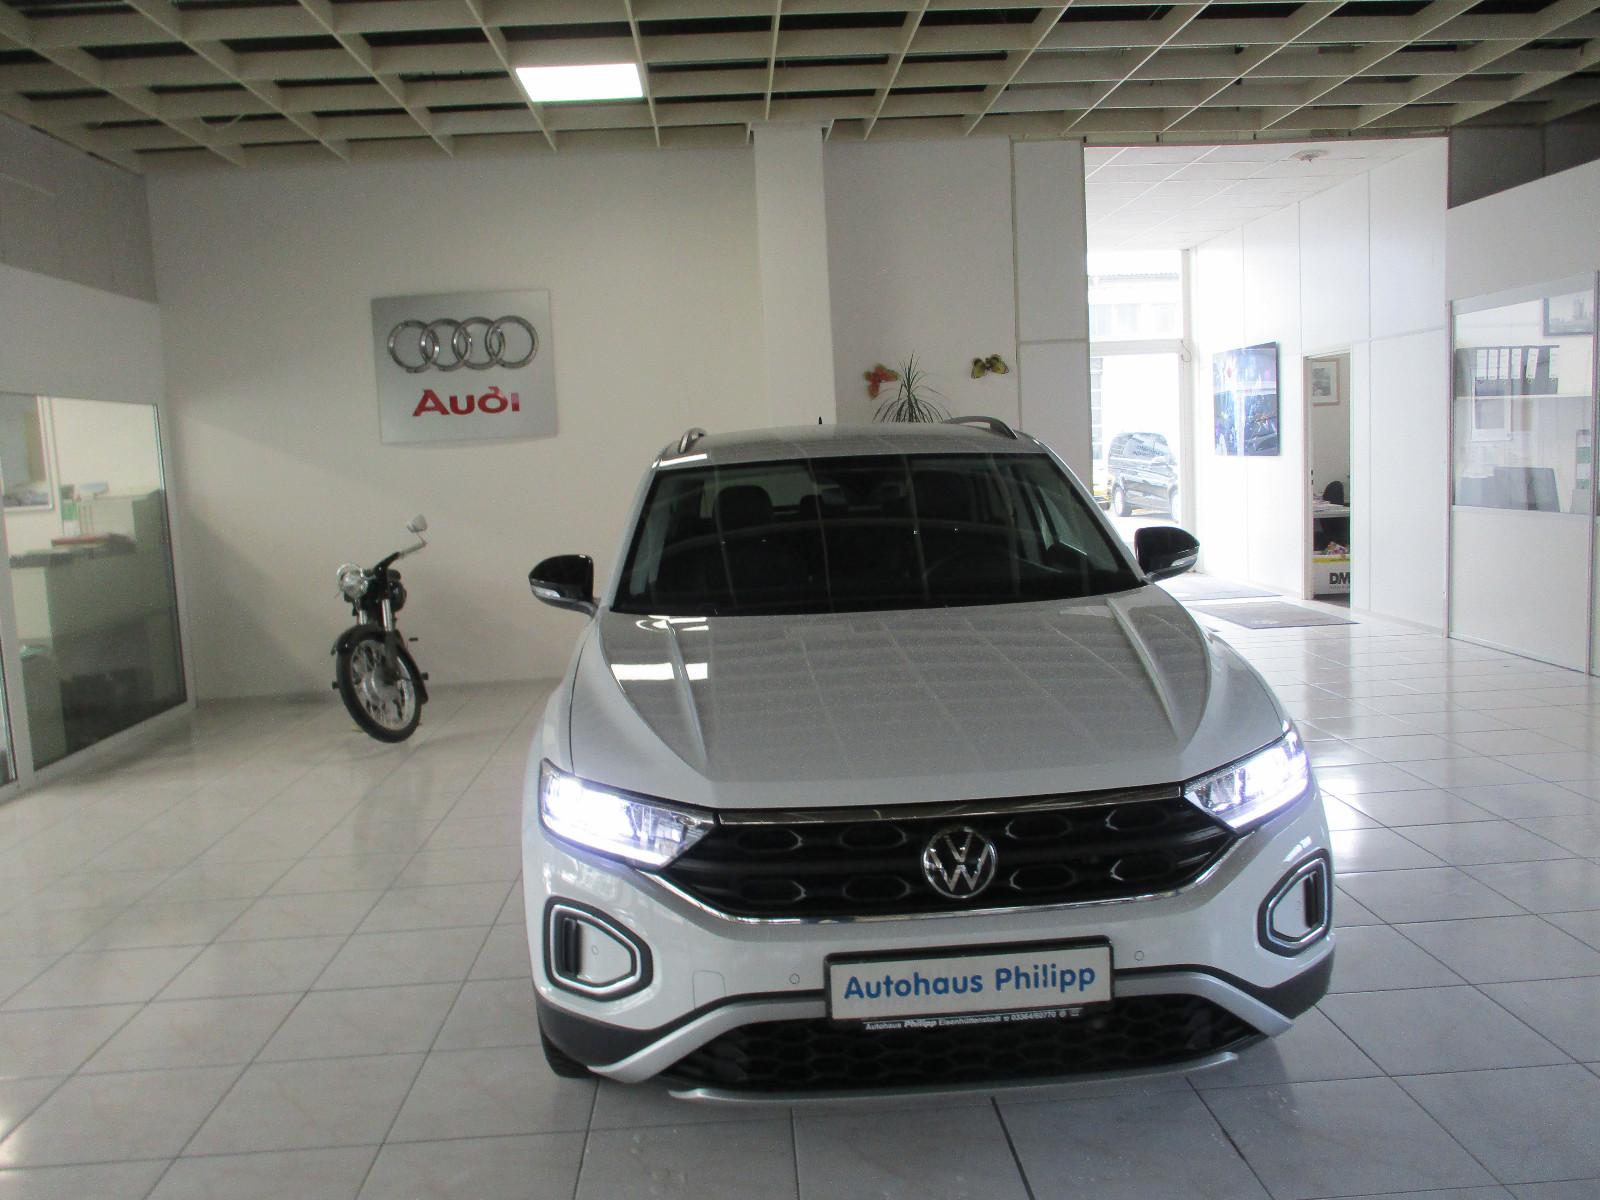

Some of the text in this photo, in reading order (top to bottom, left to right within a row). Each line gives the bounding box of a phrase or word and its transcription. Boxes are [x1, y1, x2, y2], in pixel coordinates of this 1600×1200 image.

[412, 386, 520, 417] Audi
[844, 963, 1096, 1000] Autohaus Philipp
[865, 1021, 902, 1031] Autohaus
[904, 1018, 937, 1028] Philipp
